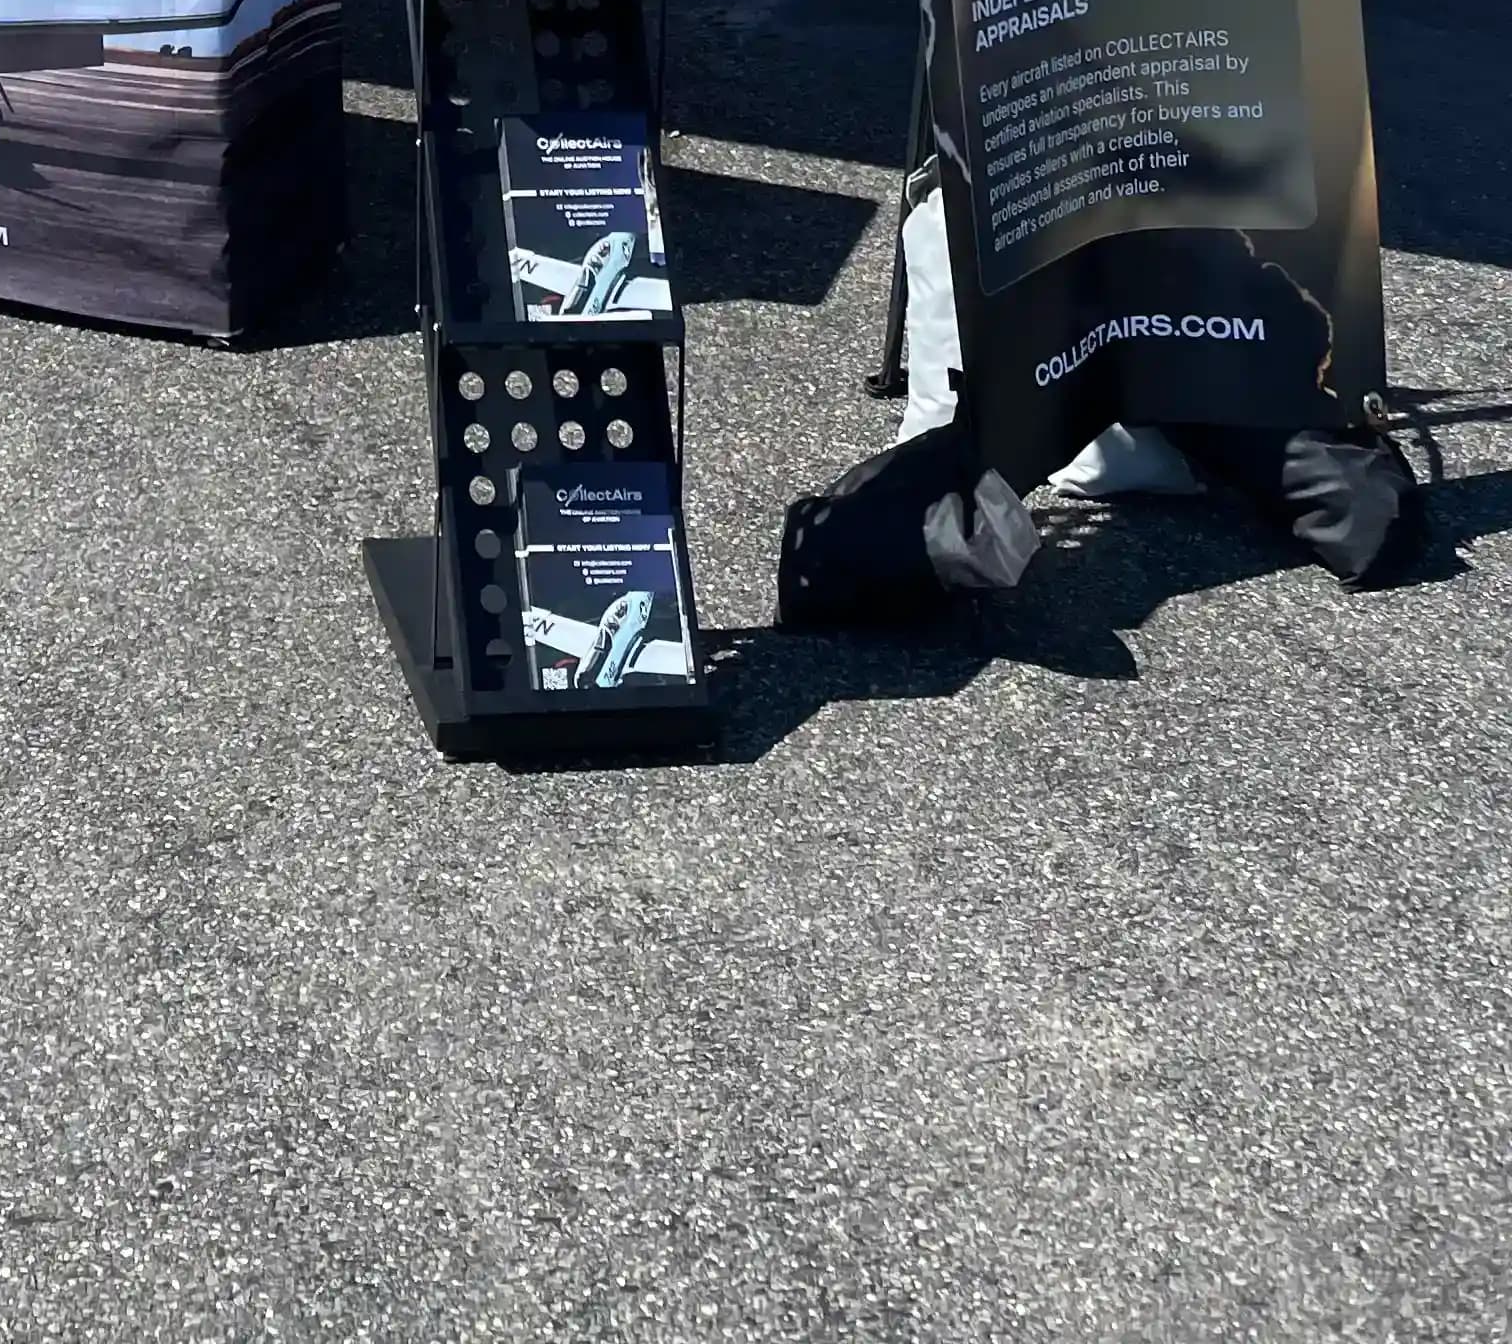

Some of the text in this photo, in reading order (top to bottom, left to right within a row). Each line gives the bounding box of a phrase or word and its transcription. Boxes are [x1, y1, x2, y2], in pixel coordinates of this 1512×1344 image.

[979, 30, 1229, 103] Every aircraft listed on COLLECTAIRS
[982, 53, 1248, 127] undergoes an independent appraisal by
[984, 79, 1190, 152] certified aviation specialists. This
[987, 100, 1263, 177] ensures full transparency for buyers and
[989, 128, 1179, 207] provides sellers with a credible,
[991, 149, 1190, 231] professional assessment of their
[993, 178, 1165, 252] aircraft's condition and value.
[1035, 314, 1265, 387] COLLECTAIRS.COM
